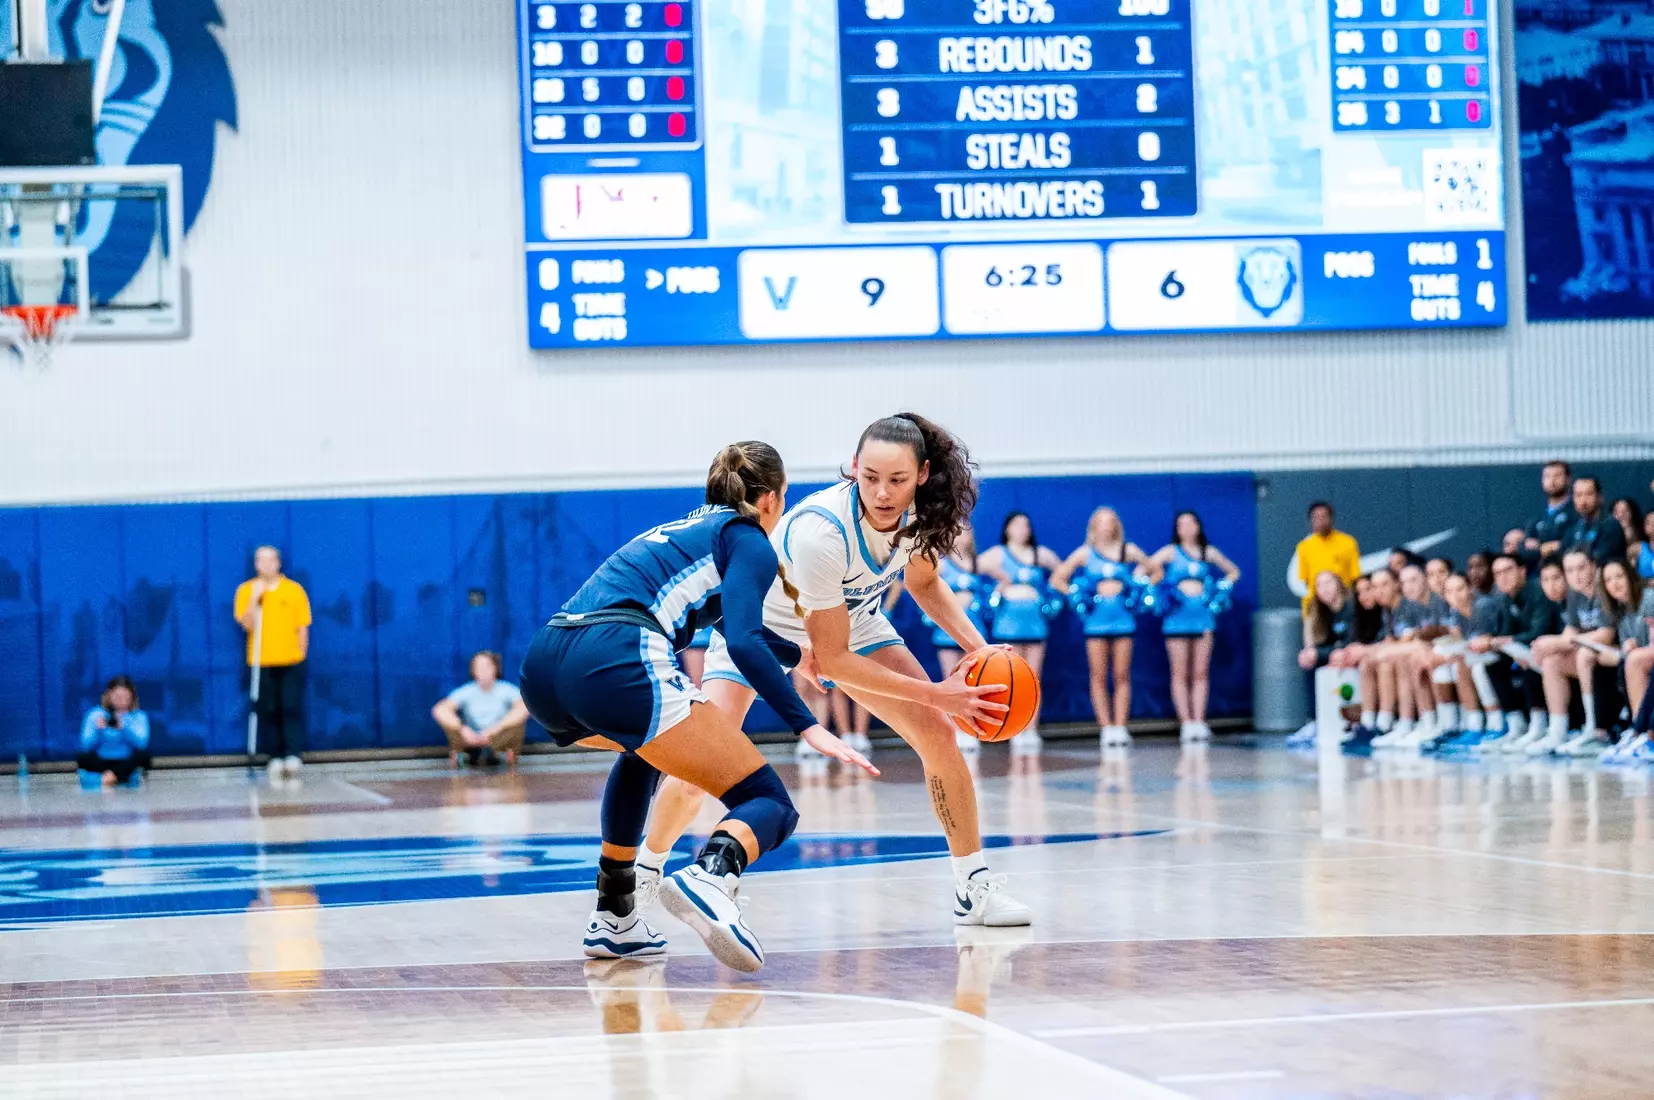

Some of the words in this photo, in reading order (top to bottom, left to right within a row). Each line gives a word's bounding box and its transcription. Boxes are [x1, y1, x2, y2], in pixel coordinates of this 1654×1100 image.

[582, 41, 598, 65] 0
[627, 41, 644, 64] 0
[938, 35, 1093, 73] REBOUNDS
[1135, 36, 1155, 65] 1
[1382, 30, 1398, 53] 0
[1425, 29, 1441, 52] 0
[628, 77, 645, 101] 0
[1383, 66, 1399, 88] 0
[1426, 64, 1442, 88] 0
[955, 84, 1078, 122] ASSISTS
[1428, 100, 1442, 124] 1
[584, 114, 601, 138] 0
[629, 113, 646, 137] 0
[879, 136, 900, 166] 1
[966, 132, 1071, 170] STEALS
[881, 185, 902, 215] 1
[934, 180, 1105, 219] TURNOVERS
[1140, 180, 1160, 210] 1
[1476, 238, 1493, 270] 1
[984, 263, 1063, 288] 6:25
[1159, 269, 1186, 301] 6
[763, 276, 797, 311] V
[860, 277, 886, 307] 9
[540, 302, 561, 334] 4
